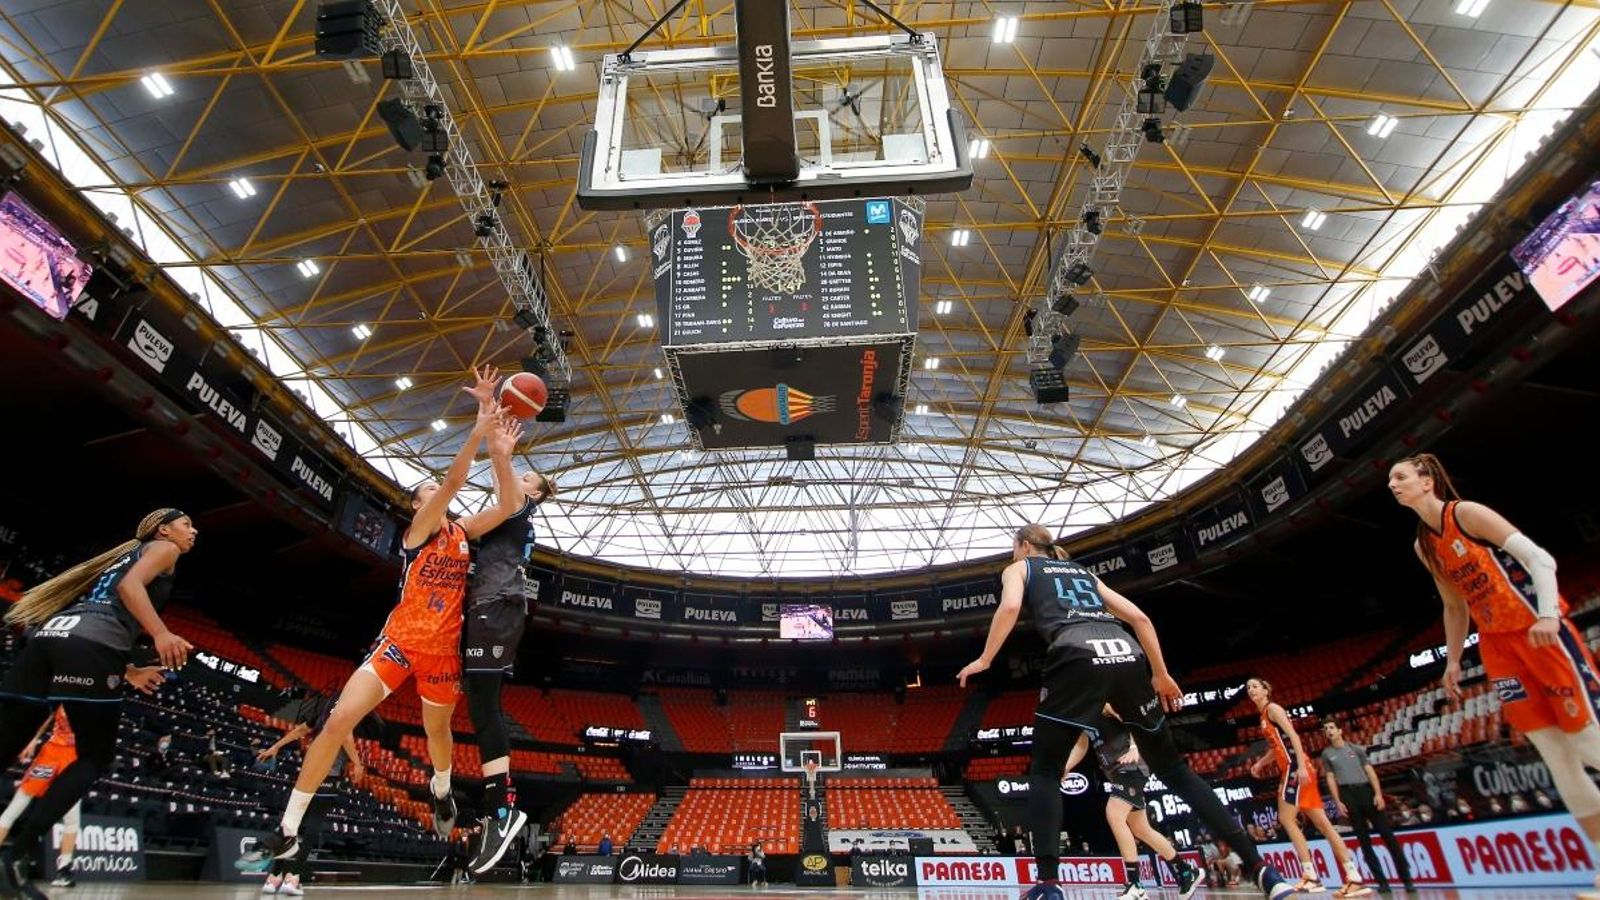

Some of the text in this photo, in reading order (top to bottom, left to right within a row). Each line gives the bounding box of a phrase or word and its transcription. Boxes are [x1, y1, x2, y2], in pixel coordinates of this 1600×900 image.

[756, 44, 777, 109] Bankia
[1456, 271, 1526, 336] PULEV
[139, 325, 170, 356] PULEVA
[1406, 339, 1436, 368] PULEVA
[186, 371, 248, 433] PULEVA
[1339, 384, 1397, 439] PULEVA
[258, 422, 281, 445] PULEVA
[1305, 437, 1325, 455] PULEVA
[290, 455, 334, 502] PULEVA
[1197, 511, 1249, 546] PULEVA
[1150, 545, 1174, 560] PULEVA
[1088, 556, 1127, 577] LEVA
[561, 591, 613, 610] PULEVA
[942, 593, 997, 612] PULEVA
[1054, 577, 1103, 608] 45
[636, 600, 661, 608] PULEVA
[684, 607, 737, 622] PULEVA
[835, 608, 868, 620] LEVA
[893, 602, 917, 610] PULEVA
[1086, 638, 1131, 657] TD
[1092, 655, 1136, 664] SYSTEMS
[52, 674, 94, 686] MADRID
[808, 706, 816, 718] 6
[53, 826, 138, 851] PMESA
[1456, 826, 1595, 875] PAMESA
[624, 858, 677, 880] Midea
[861, 859, 908, 877] teika
[922, 862, 1006, 881] PAMESA
[1028, 861, 1114, 882] PMESA
